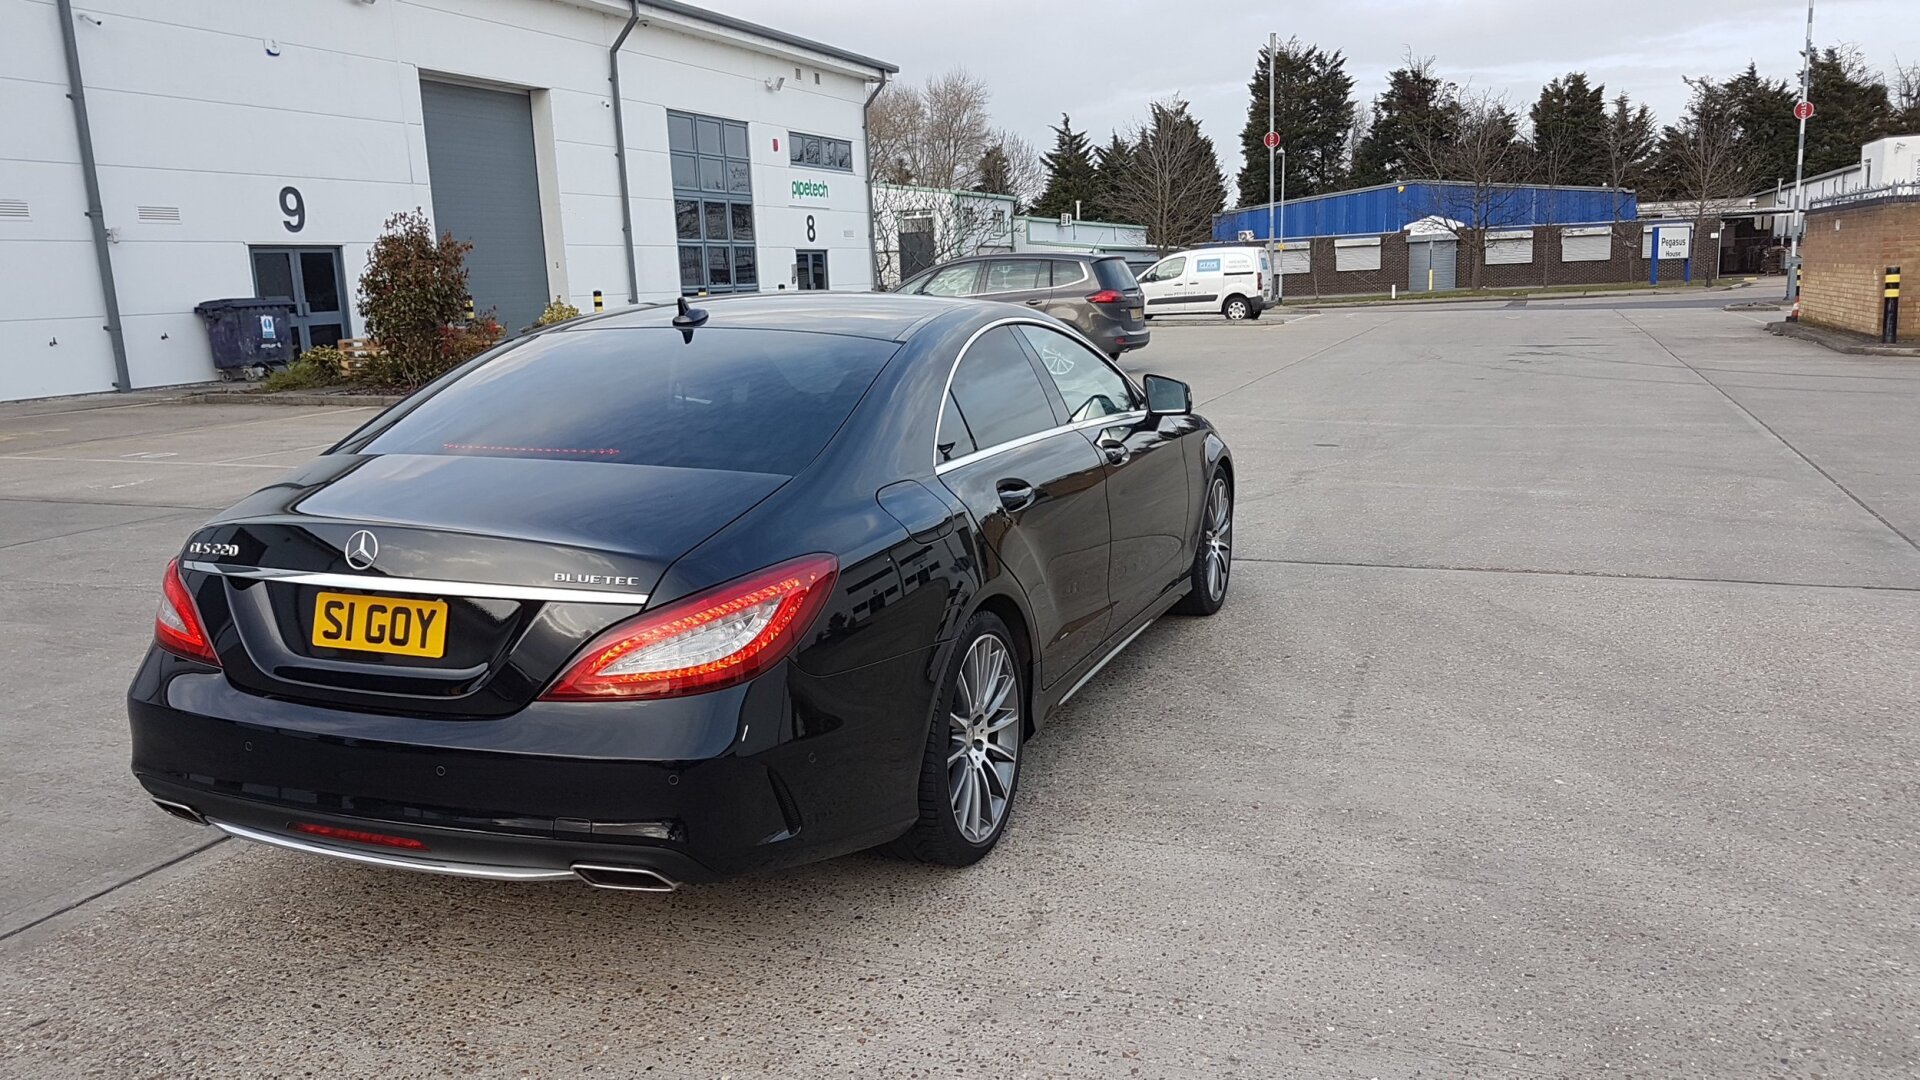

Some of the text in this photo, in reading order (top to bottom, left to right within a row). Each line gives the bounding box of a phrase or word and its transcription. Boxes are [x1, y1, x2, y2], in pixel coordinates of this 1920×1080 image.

[791, 179, 829, 199] pipetech
[279, 186, 305, 233] 9
[806, 214, 816, 242] 8
[1661, 237, 1686, 248] Pegasus
[554, 572, 640, 586] BLUETEC
[364, 603, 437, 649] GOY
